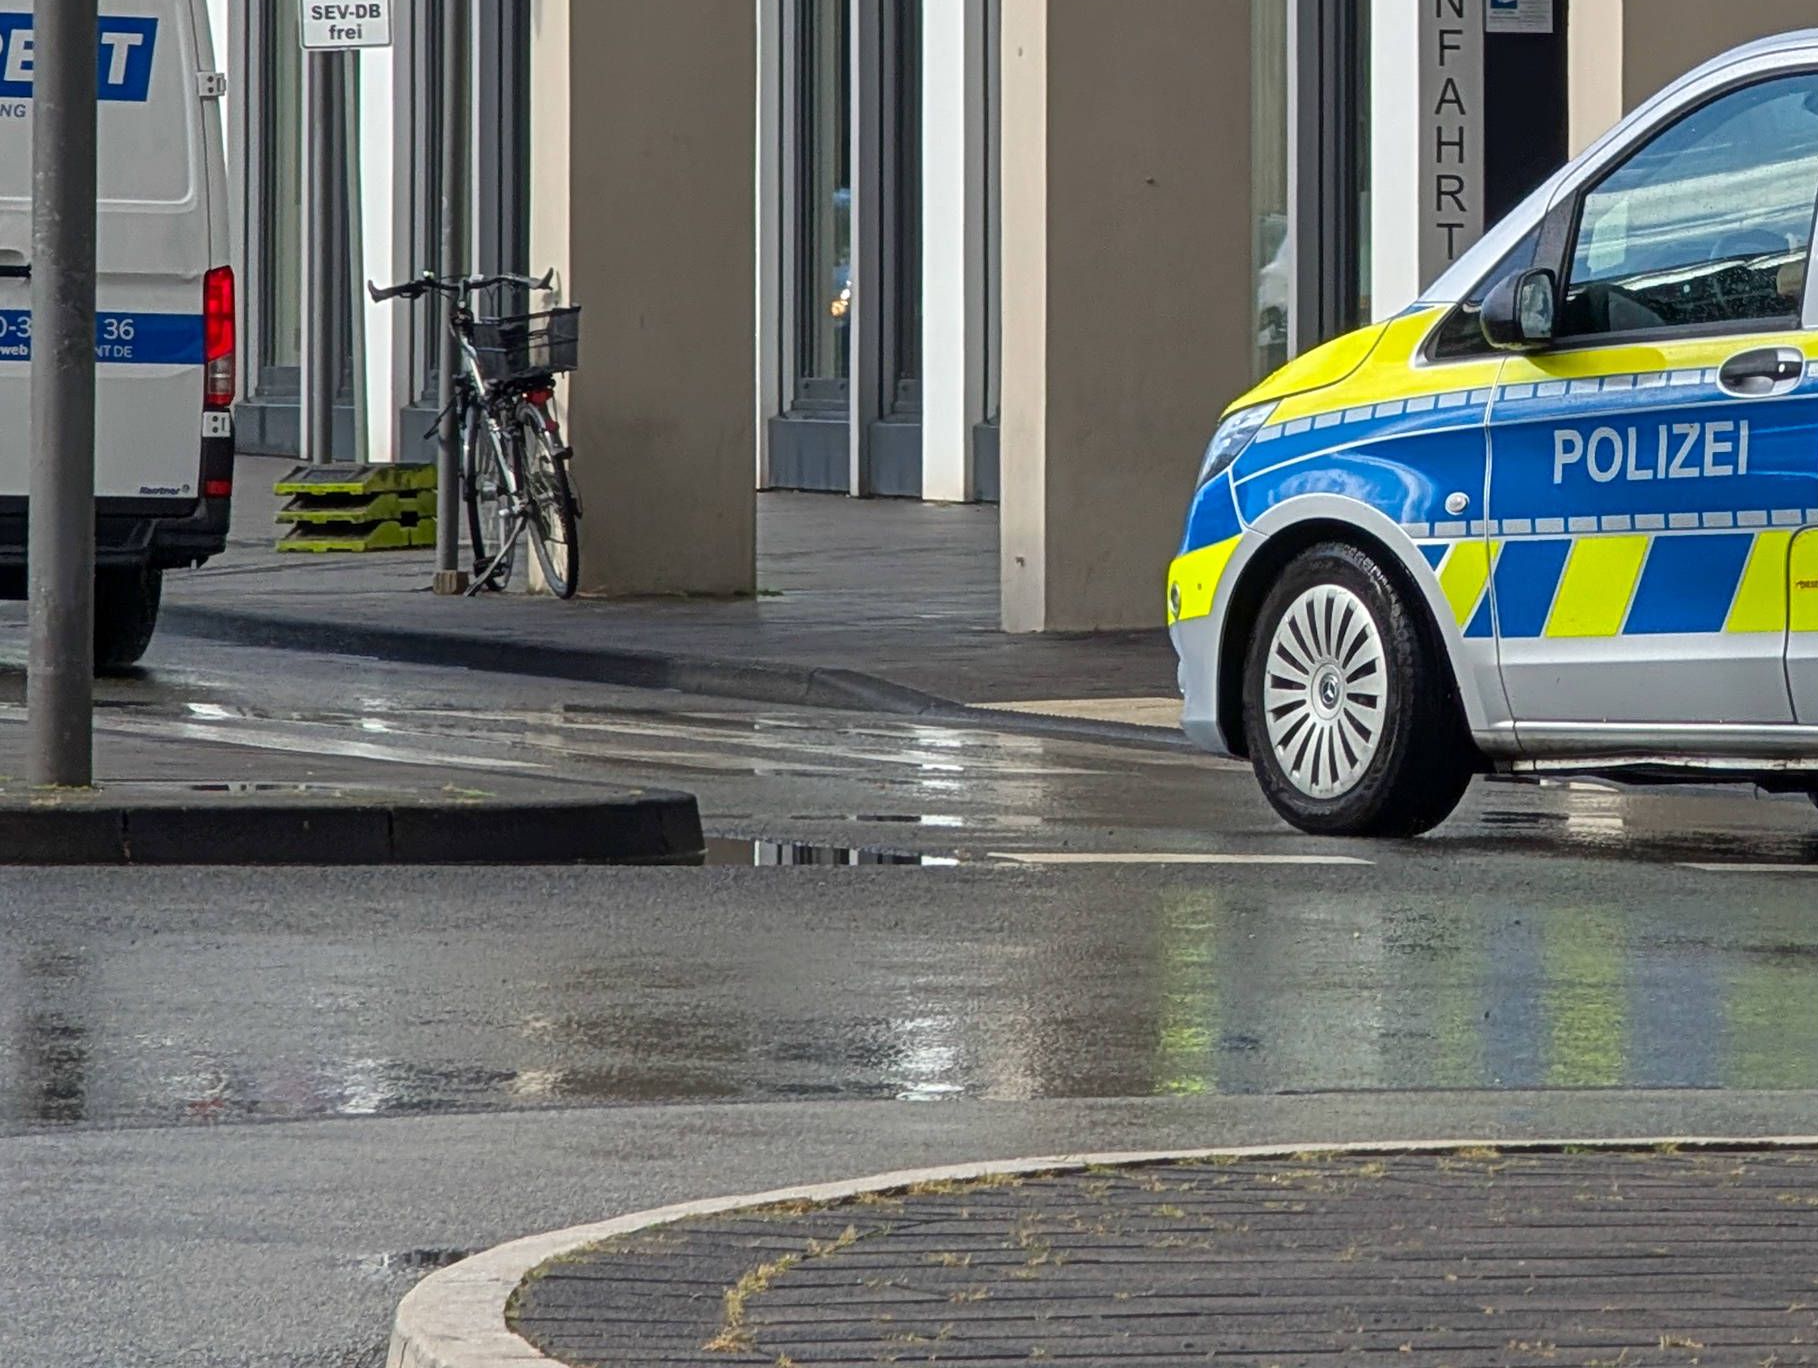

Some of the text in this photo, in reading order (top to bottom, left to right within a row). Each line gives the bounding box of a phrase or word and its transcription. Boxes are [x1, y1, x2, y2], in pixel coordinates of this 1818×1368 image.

[311, 3, 381, 20] SEV-DB
[328, 24, 363, 40] frei
[103, 318, 135, 340] 36
[1553, 420, 1749, 484] POLIZEI
